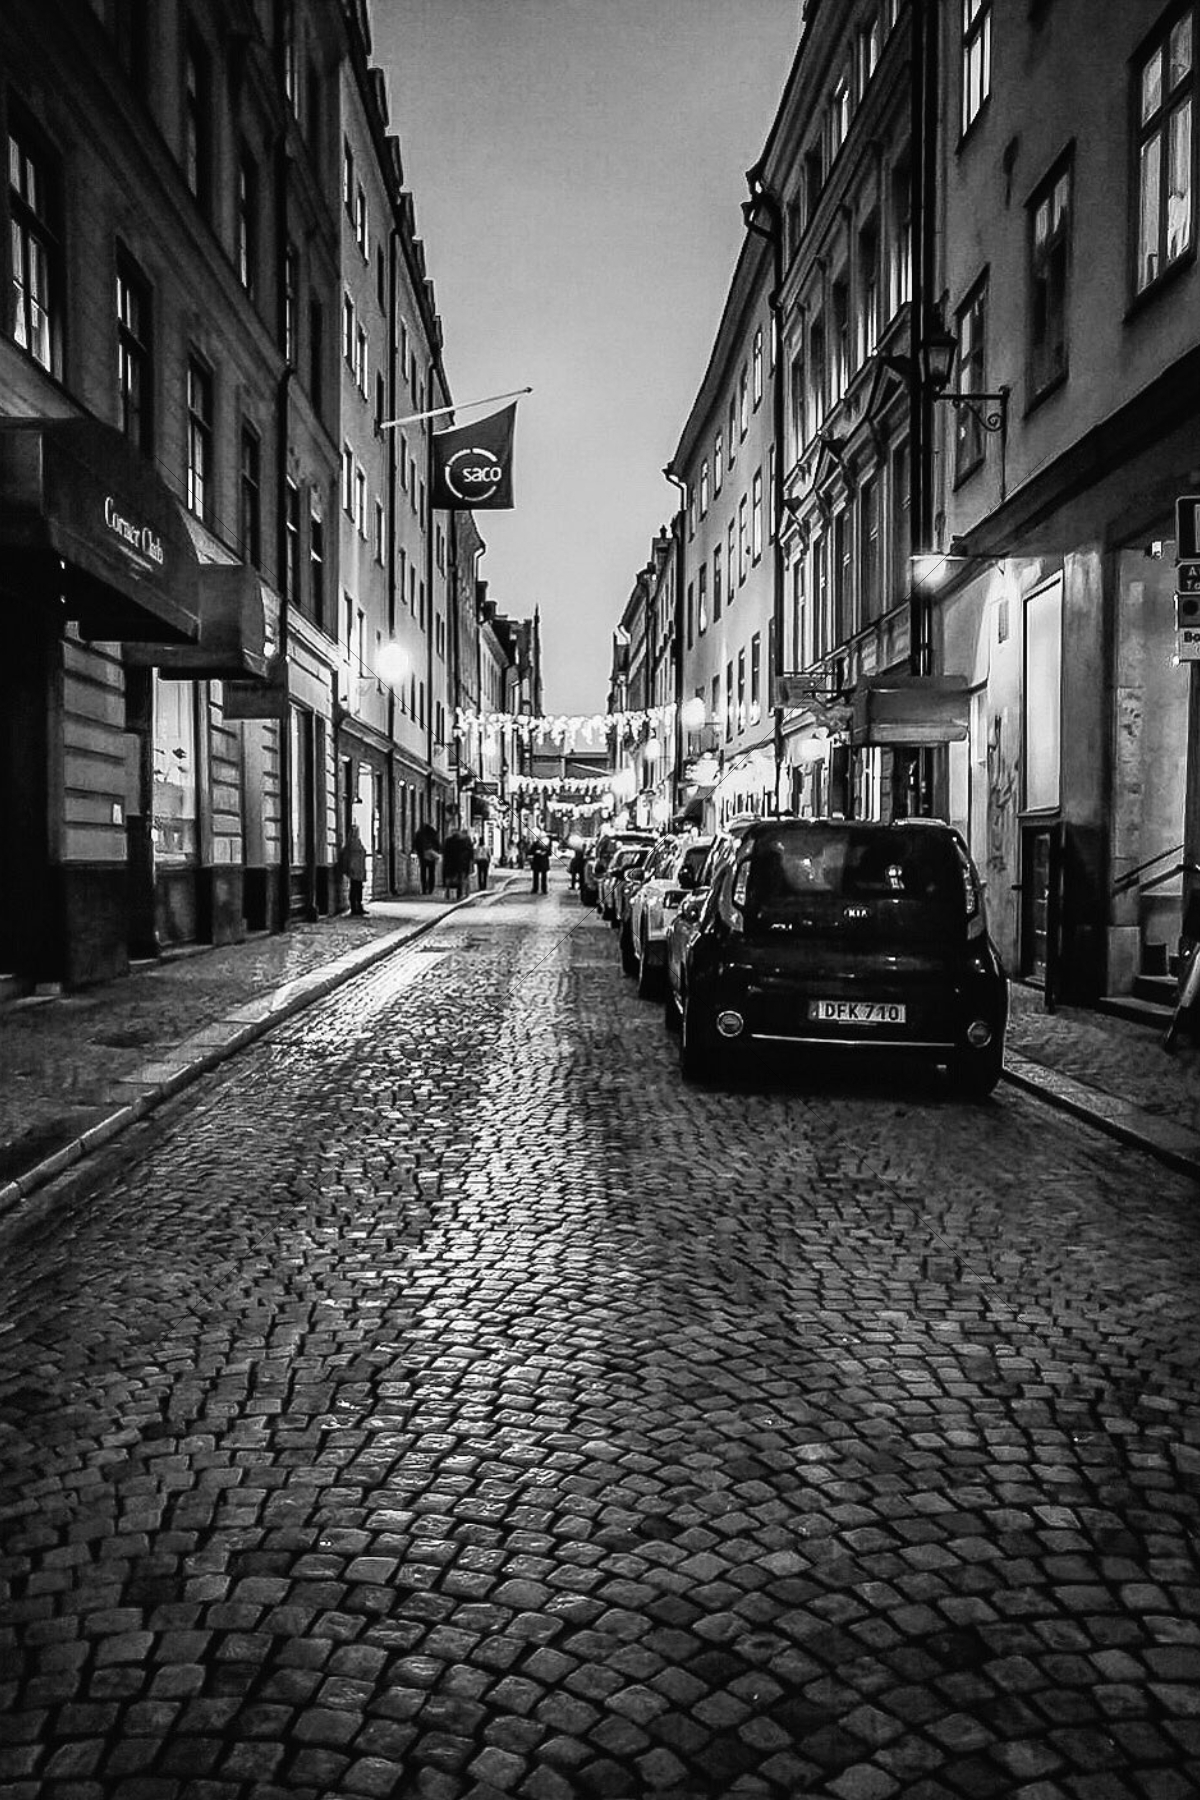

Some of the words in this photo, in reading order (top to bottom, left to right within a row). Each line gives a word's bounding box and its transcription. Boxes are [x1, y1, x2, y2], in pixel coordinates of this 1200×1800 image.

[462, 467, 502, 482] saco
[824, 1002, 859, 1020] DFK
[864, 1004, 900, 1021] 710
